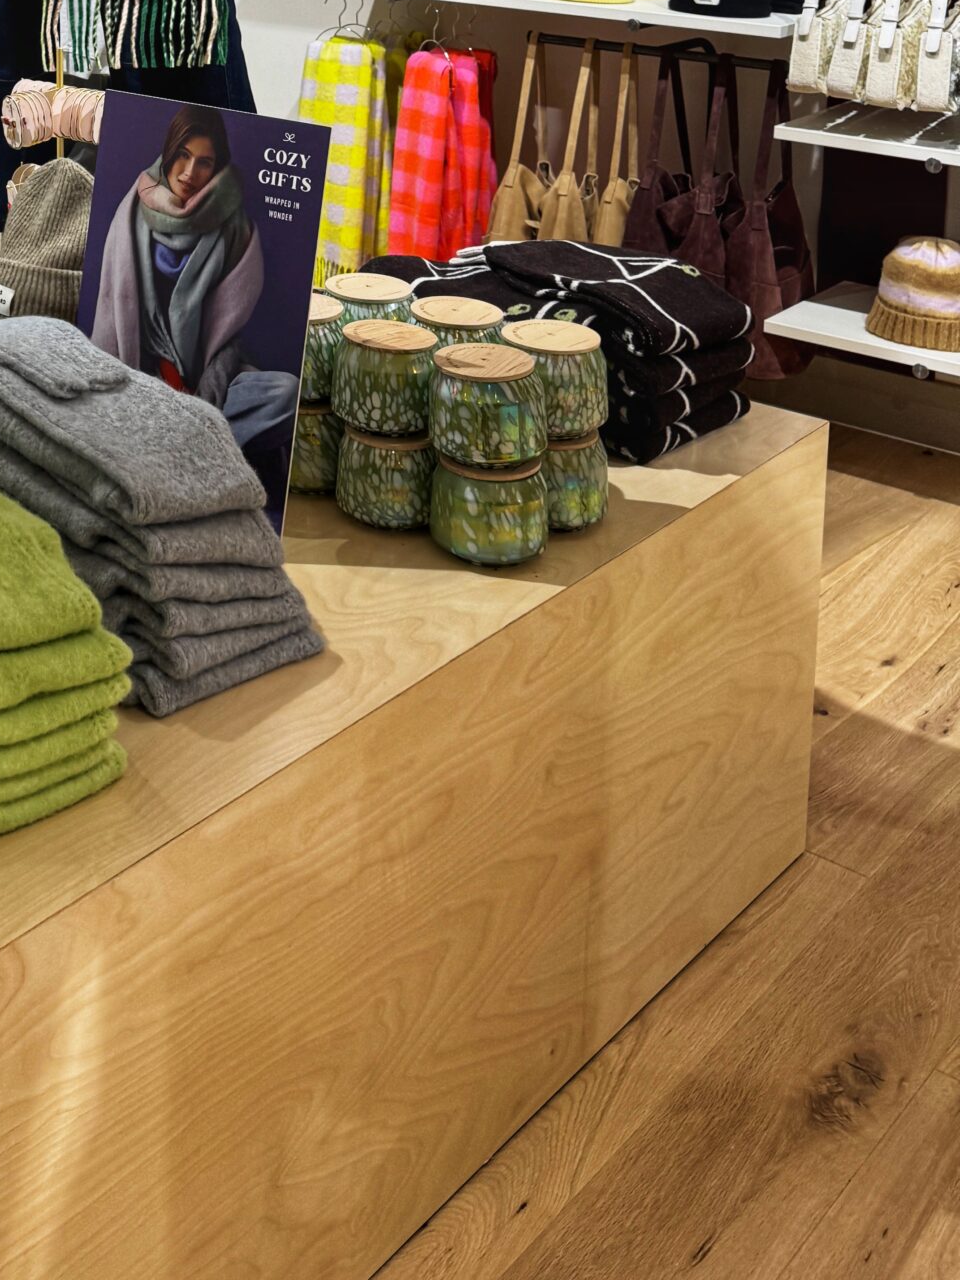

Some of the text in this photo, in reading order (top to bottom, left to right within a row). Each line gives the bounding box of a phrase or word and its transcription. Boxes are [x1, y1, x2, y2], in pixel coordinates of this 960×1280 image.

[263, 147, 312, 169] COZY
[257, 169, 312, 193] GIFTS
[264, 195, 300, 210] WRAPPED IN
[268, 209, 293, 222] WONDER
